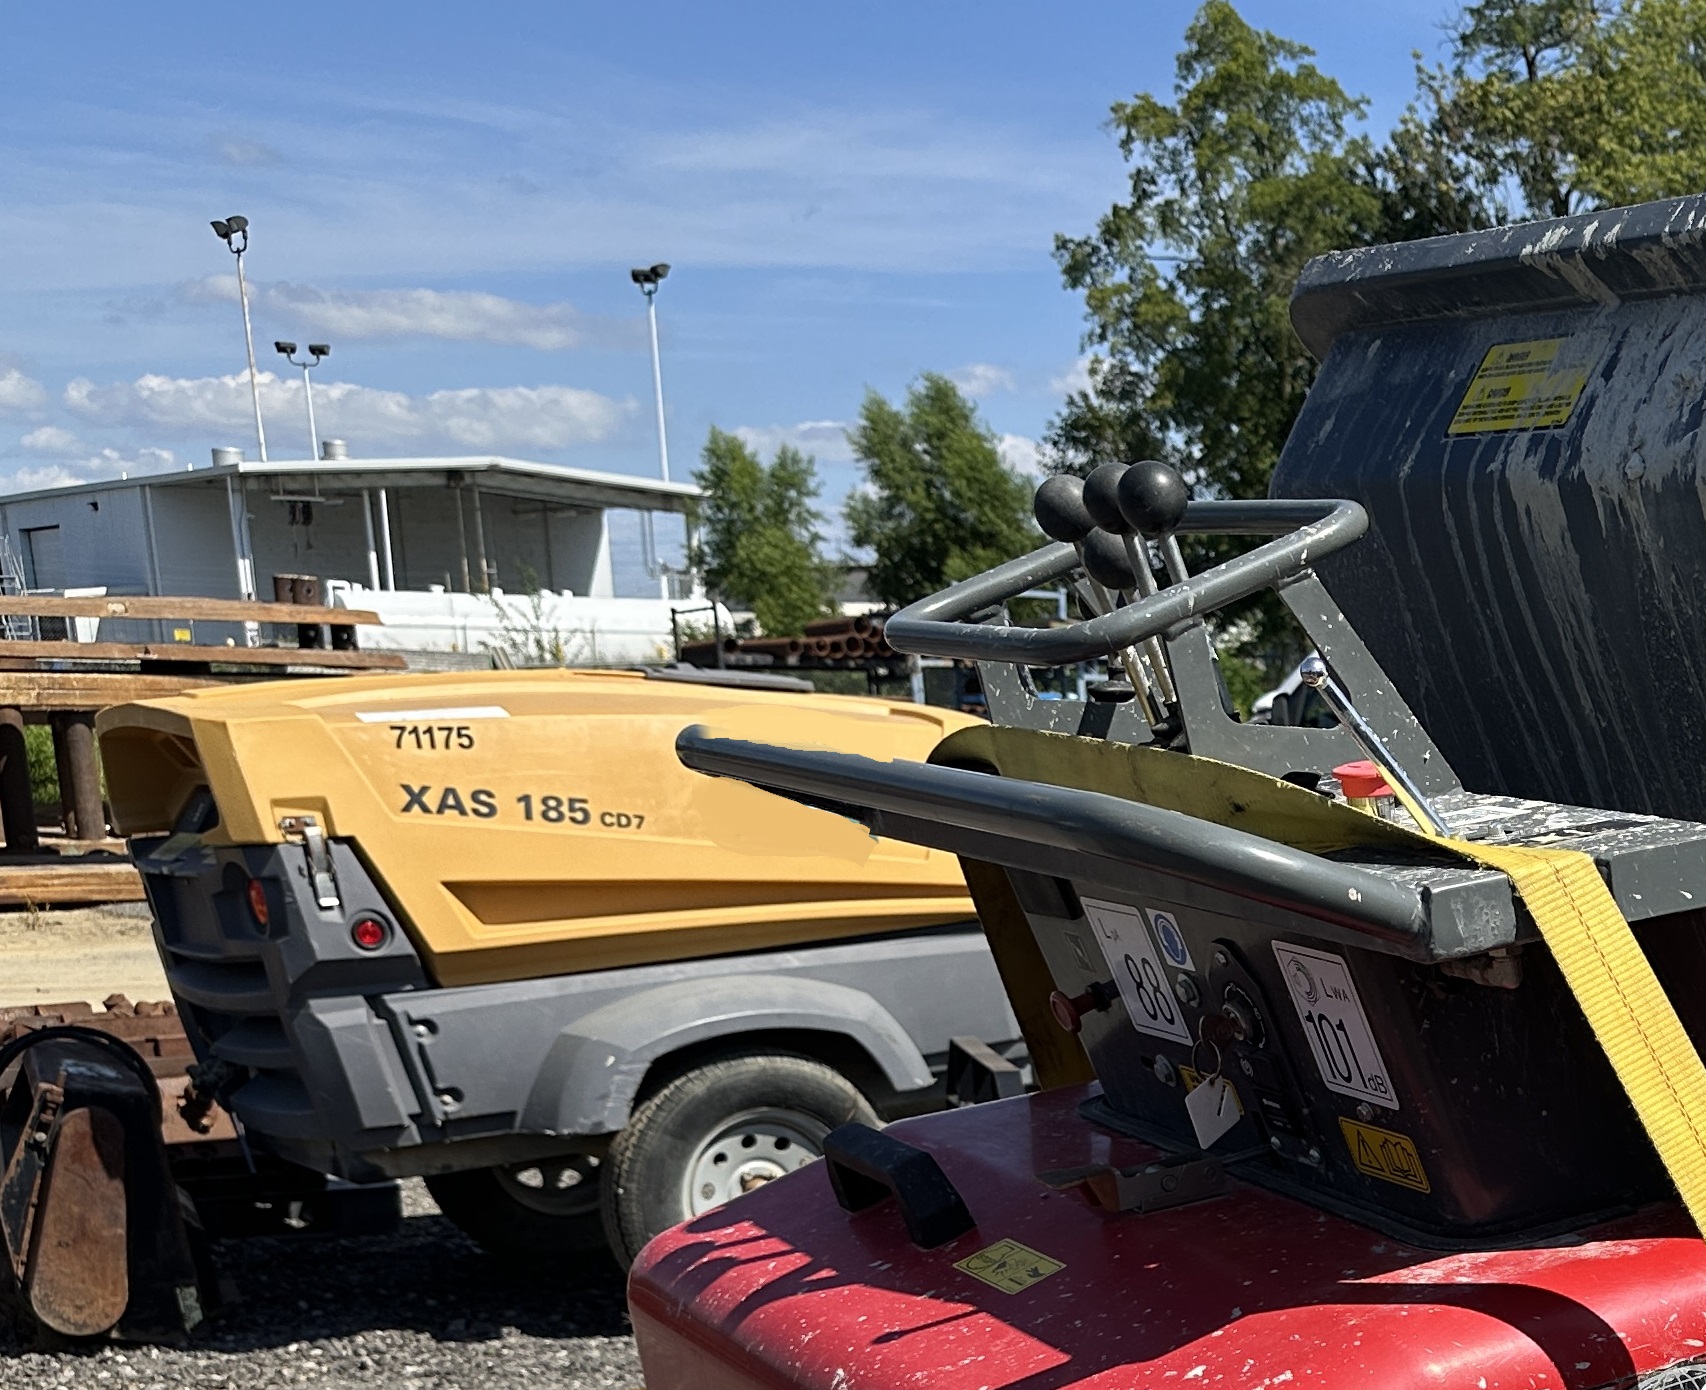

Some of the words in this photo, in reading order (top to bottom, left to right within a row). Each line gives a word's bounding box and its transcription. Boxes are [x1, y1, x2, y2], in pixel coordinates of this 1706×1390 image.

[389, 724, 475, 750] 71175
[399, 783, 499, 819] XAS
[516, 793, 592, 826] 185
[599, 811, 646, 830] CD7
[1124, 953, 1176, 1026] 88
[1304, 1009, 1369, 1090] 101
